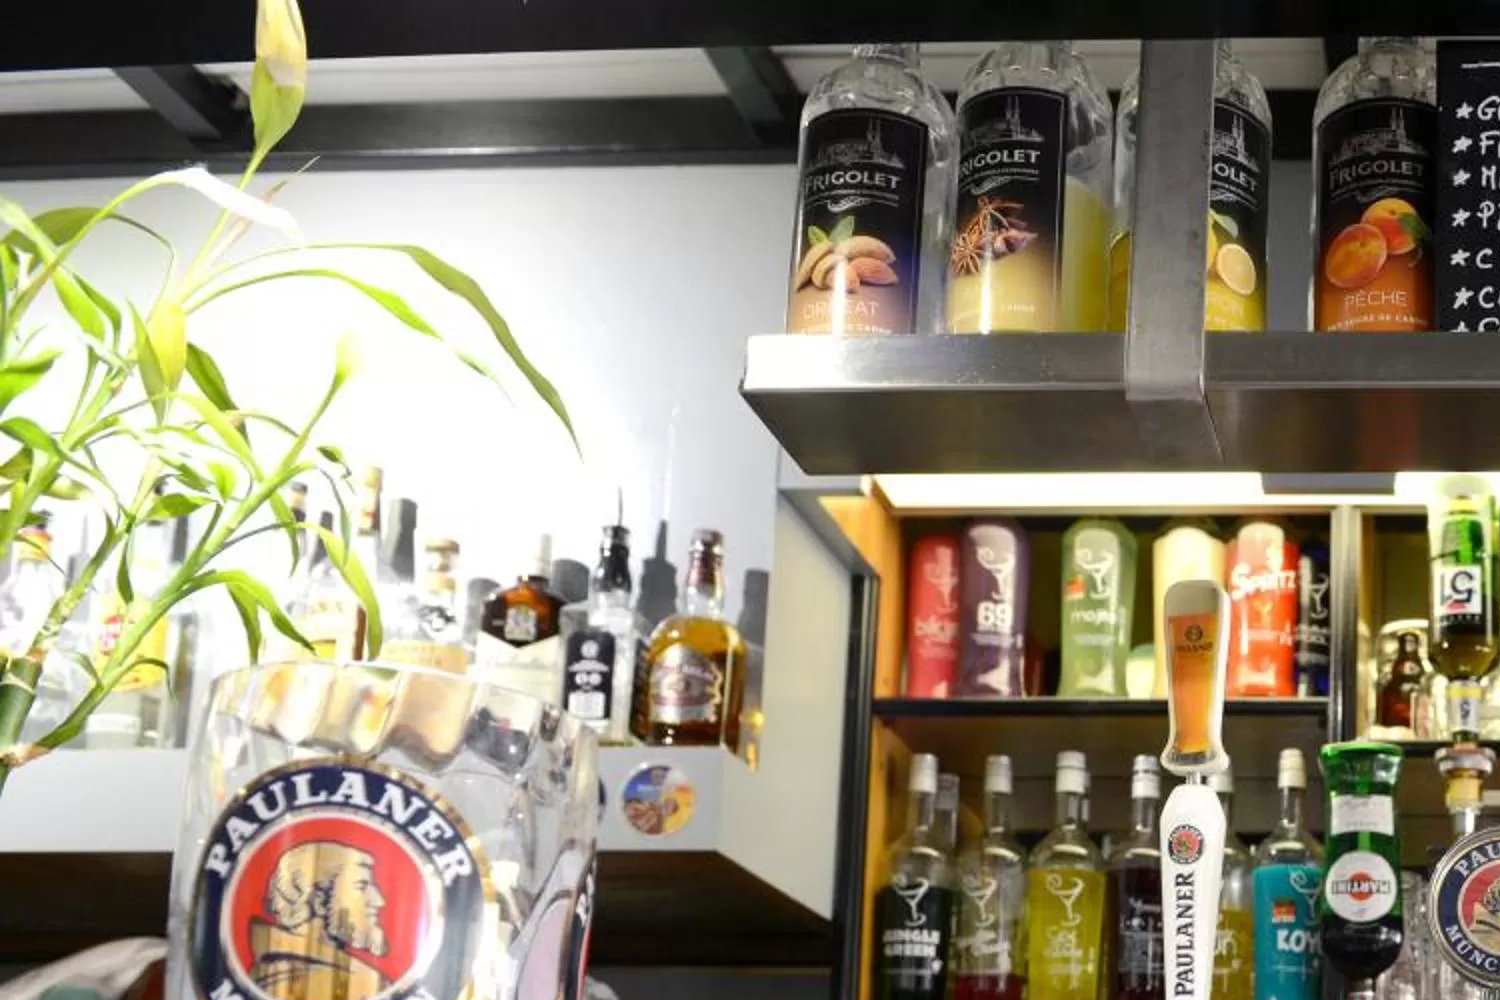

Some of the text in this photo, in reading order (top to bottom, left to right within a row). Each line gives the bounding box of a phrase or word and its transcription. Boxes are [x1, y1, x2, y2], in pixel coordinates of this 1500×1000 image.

[803, 170, 900, 195] FRIGOLET
[1328, 160, 1426, 191] FRIGOLET
[1345, 289, 1409, 309] PÊCHE
[204, 770, 475, 888] PAULANER
[1175, 870, 1196, 997] PAULANER
